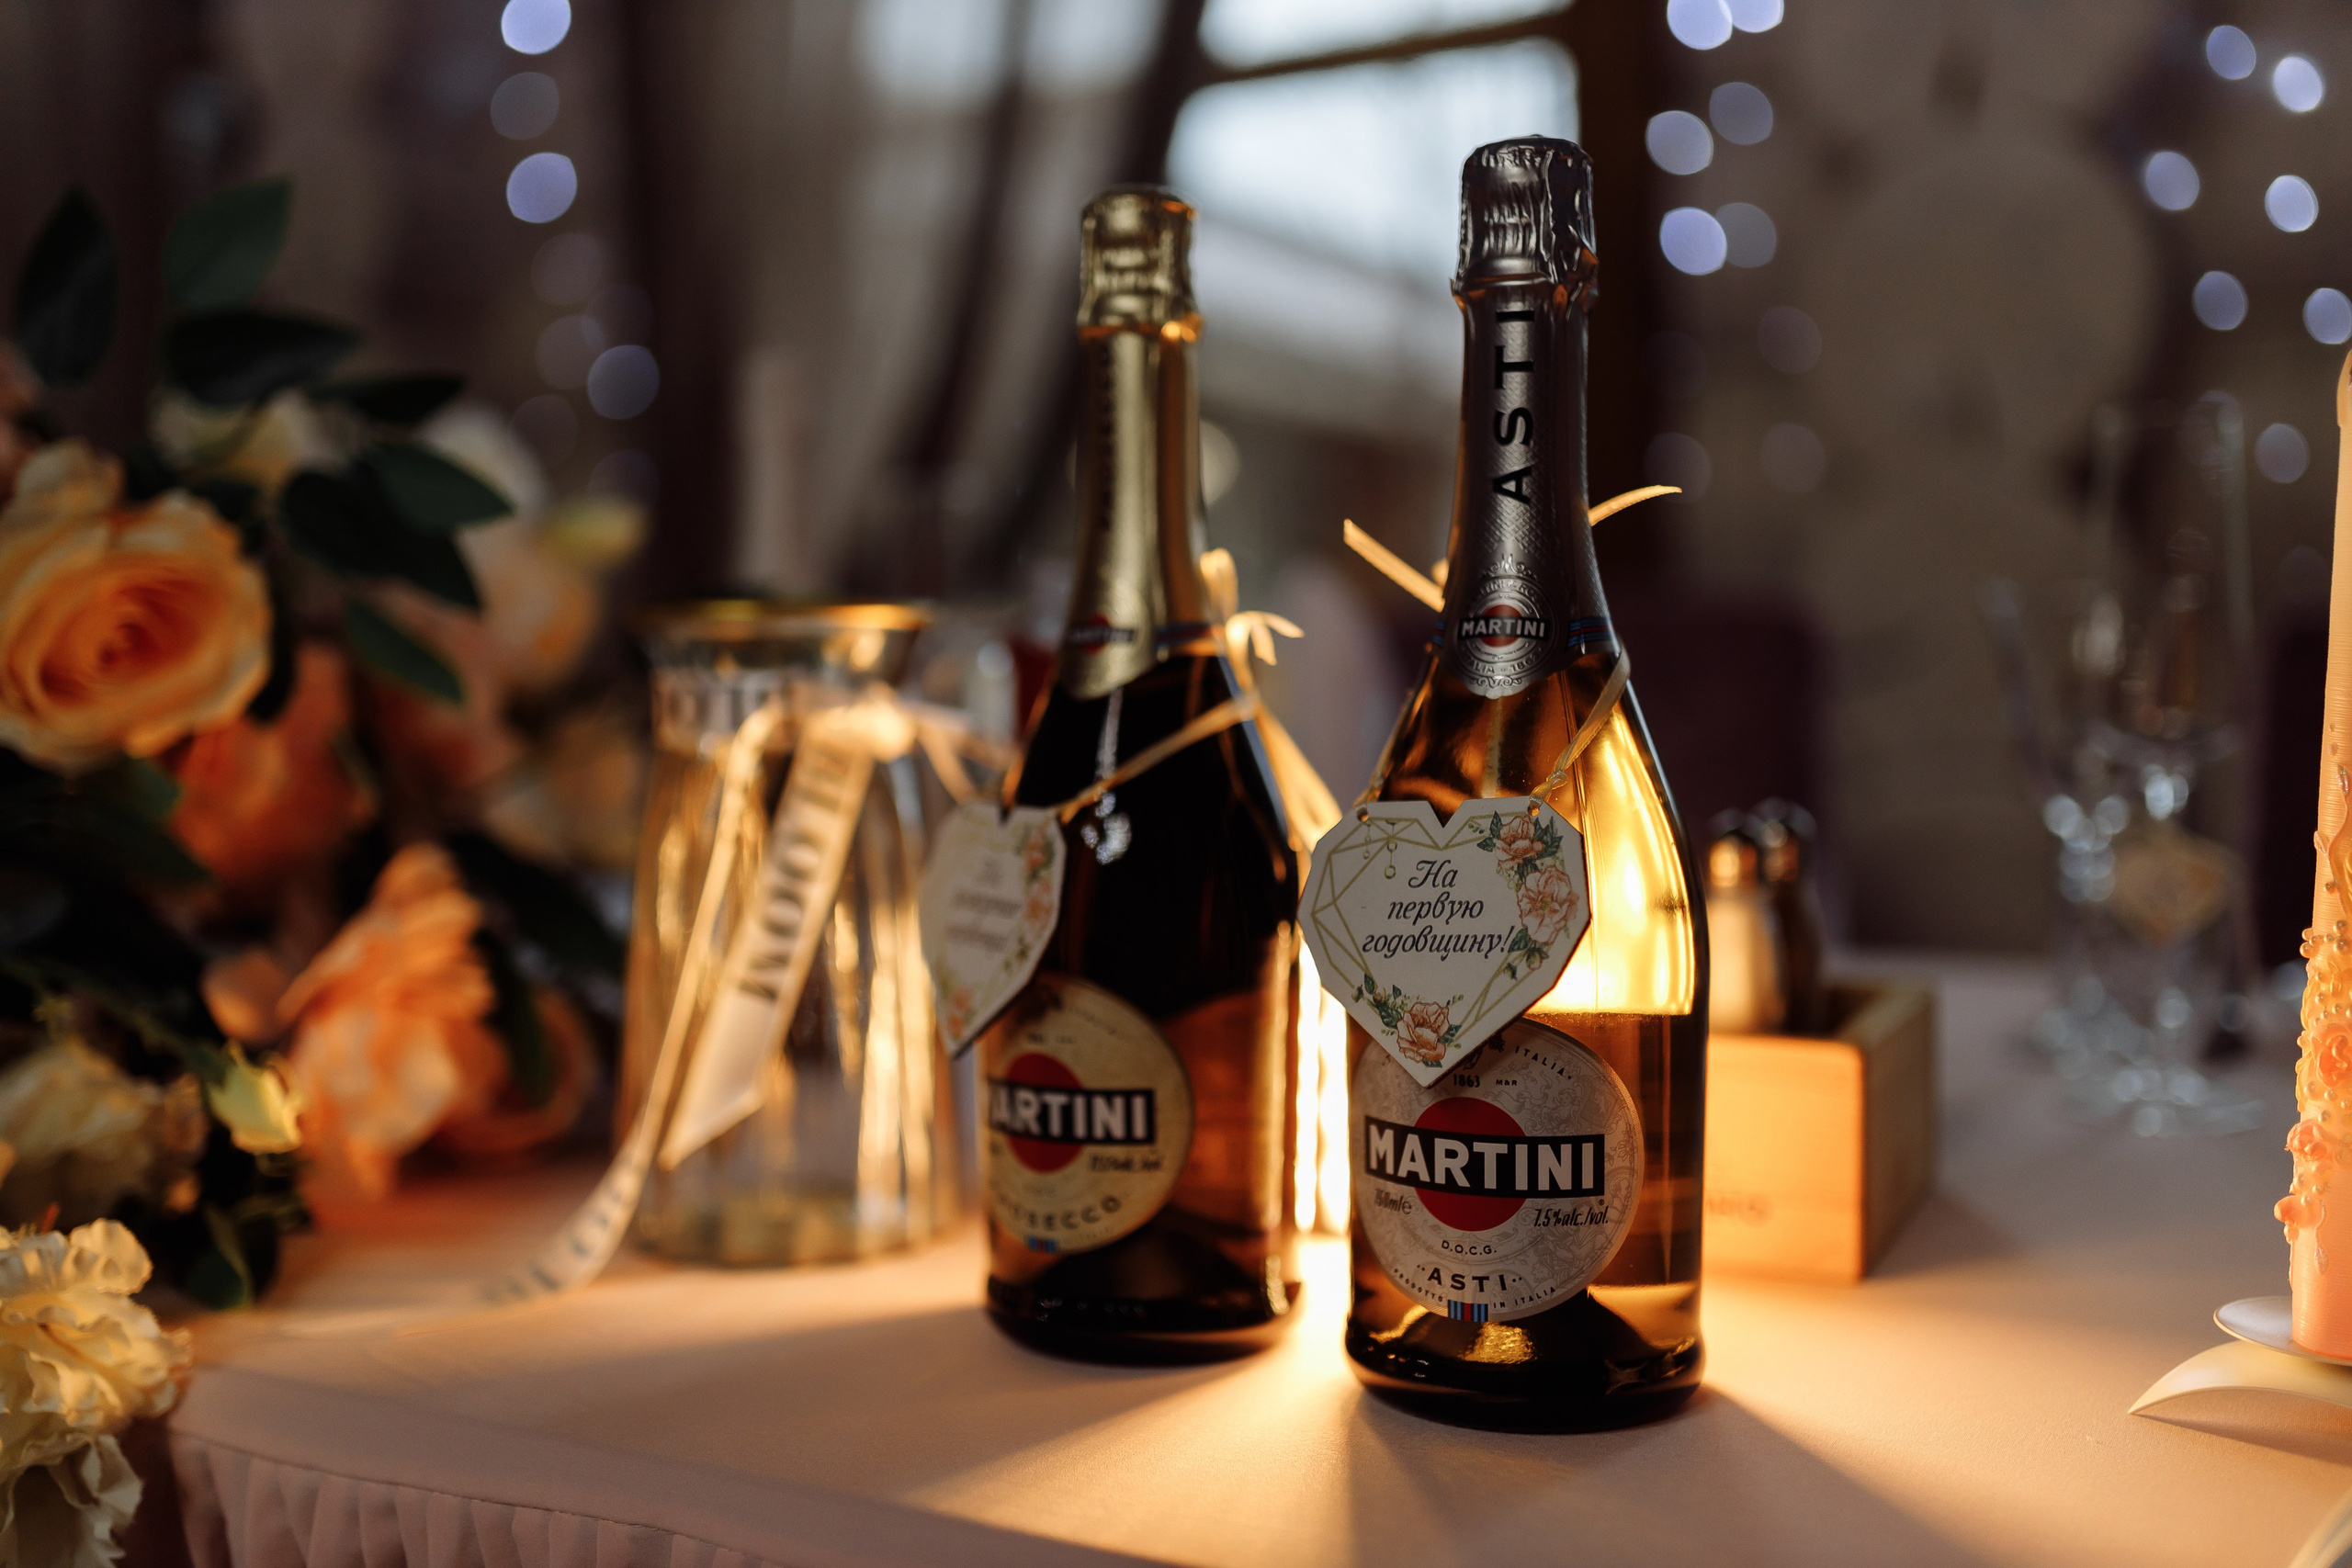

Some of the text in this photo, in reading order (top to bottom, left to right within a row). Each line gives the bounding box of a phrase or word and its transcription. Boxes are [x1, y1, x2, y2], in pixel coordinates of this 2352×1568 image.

[1492, 310, 1534, 505] ASTI
[1462, 618, 1545, 637] MARTINI
[1408, 860, 1456, 889] На
[1387, 891, 1484, 925] первую
[1363, 926, 1515, 961] годовщину!
[1453, 1074, 1481, 1089] 1863
[989, 1083, 1148, 1141] ARTINI
[1368, 1123, 1594, 1191] MARTINI
[1442, 1240, 1498, 1256] D.O.C.G.
[1427, 1267, 1507, 1293] ASTI
[1492, 1300, 1506, 1309] IN
[1515, 1287, 1556, 1306] ITALIA
